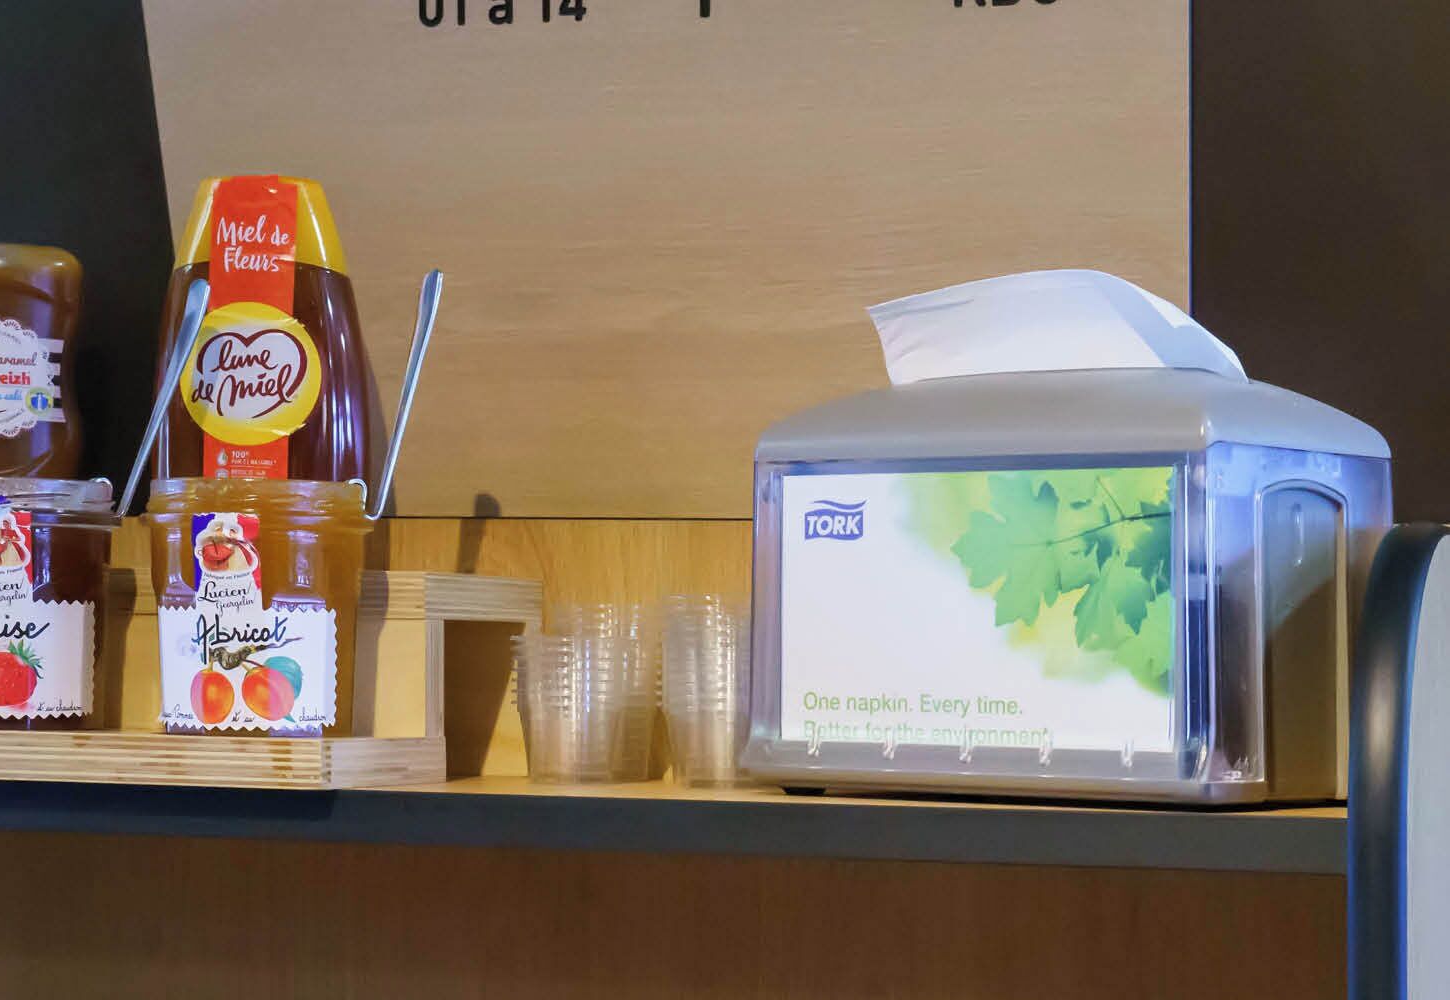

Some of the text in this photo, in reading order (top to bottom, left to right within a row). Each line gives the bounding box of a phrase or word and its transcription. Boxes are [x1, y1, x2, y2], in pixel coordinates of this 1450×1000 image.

[217, 215, 290, 246] Miel de
[224, 246, 281, 273] Fleurs
[209, 339, 278, 372] lune
[191, 378, 214, 404] de
[806, 515, 861, 537] TORK
[197, 580, 250, 603] Lucien
[215, 596, 254, 616] Georgelin
[191, 614, 288, 665] Abricot
[803, 692, 1023, 719] One napkin. Every time.
